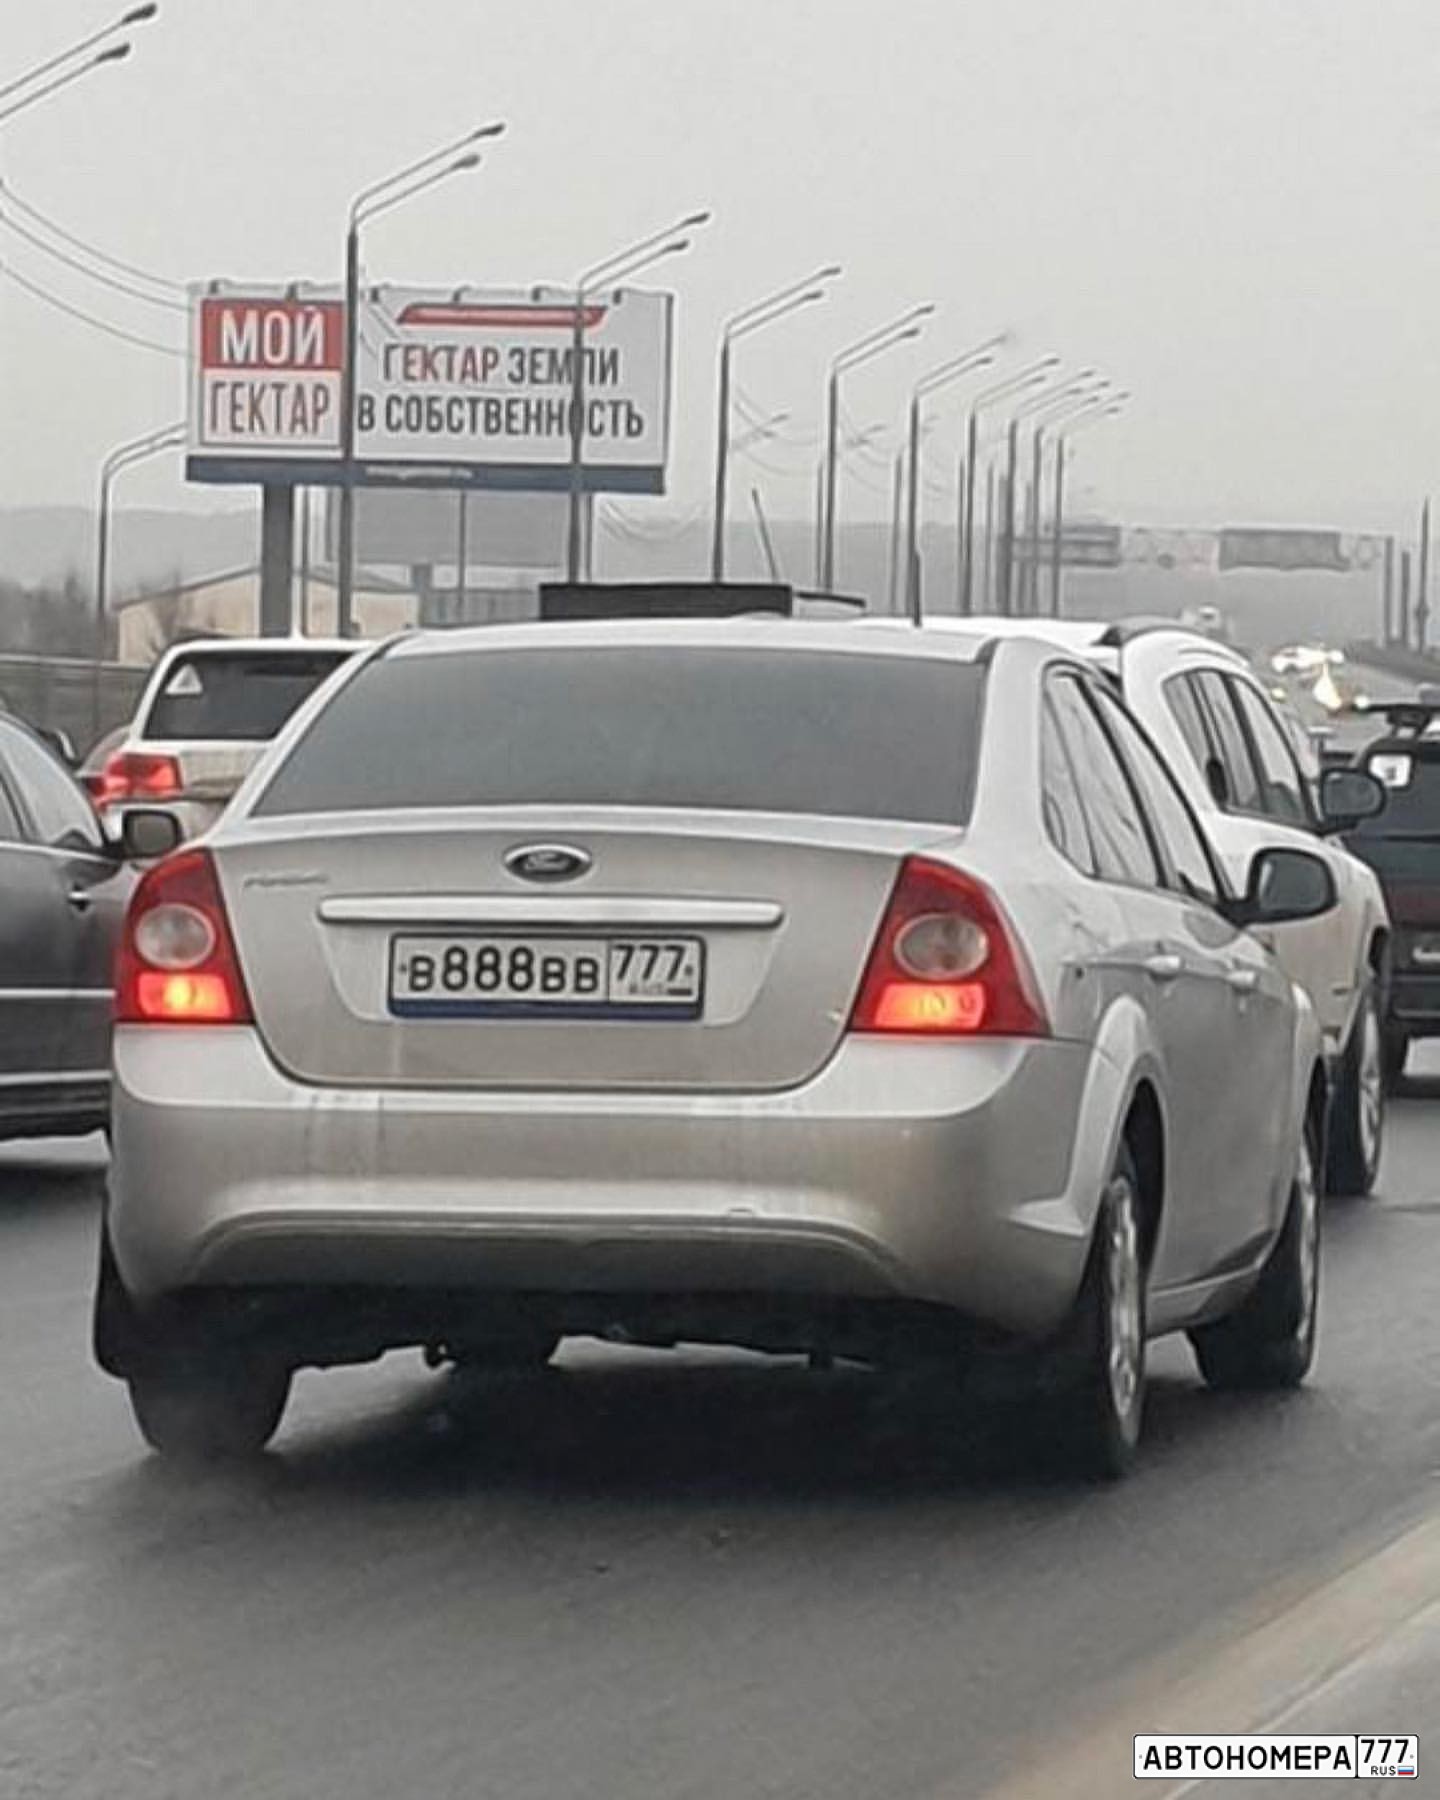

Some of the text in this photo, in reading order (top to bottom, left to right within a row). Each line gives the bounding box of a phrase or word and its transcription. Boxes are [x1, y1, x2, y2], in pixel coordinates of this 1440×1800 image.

[220, 305, 325, 366] МОЙ
[383, 344, 498, 384] ГЕКТАР
[210, 381, 330, 434] ГЕКТАР
[357, 394, 376, 432] В
[614, 944, 686, 982] 777
